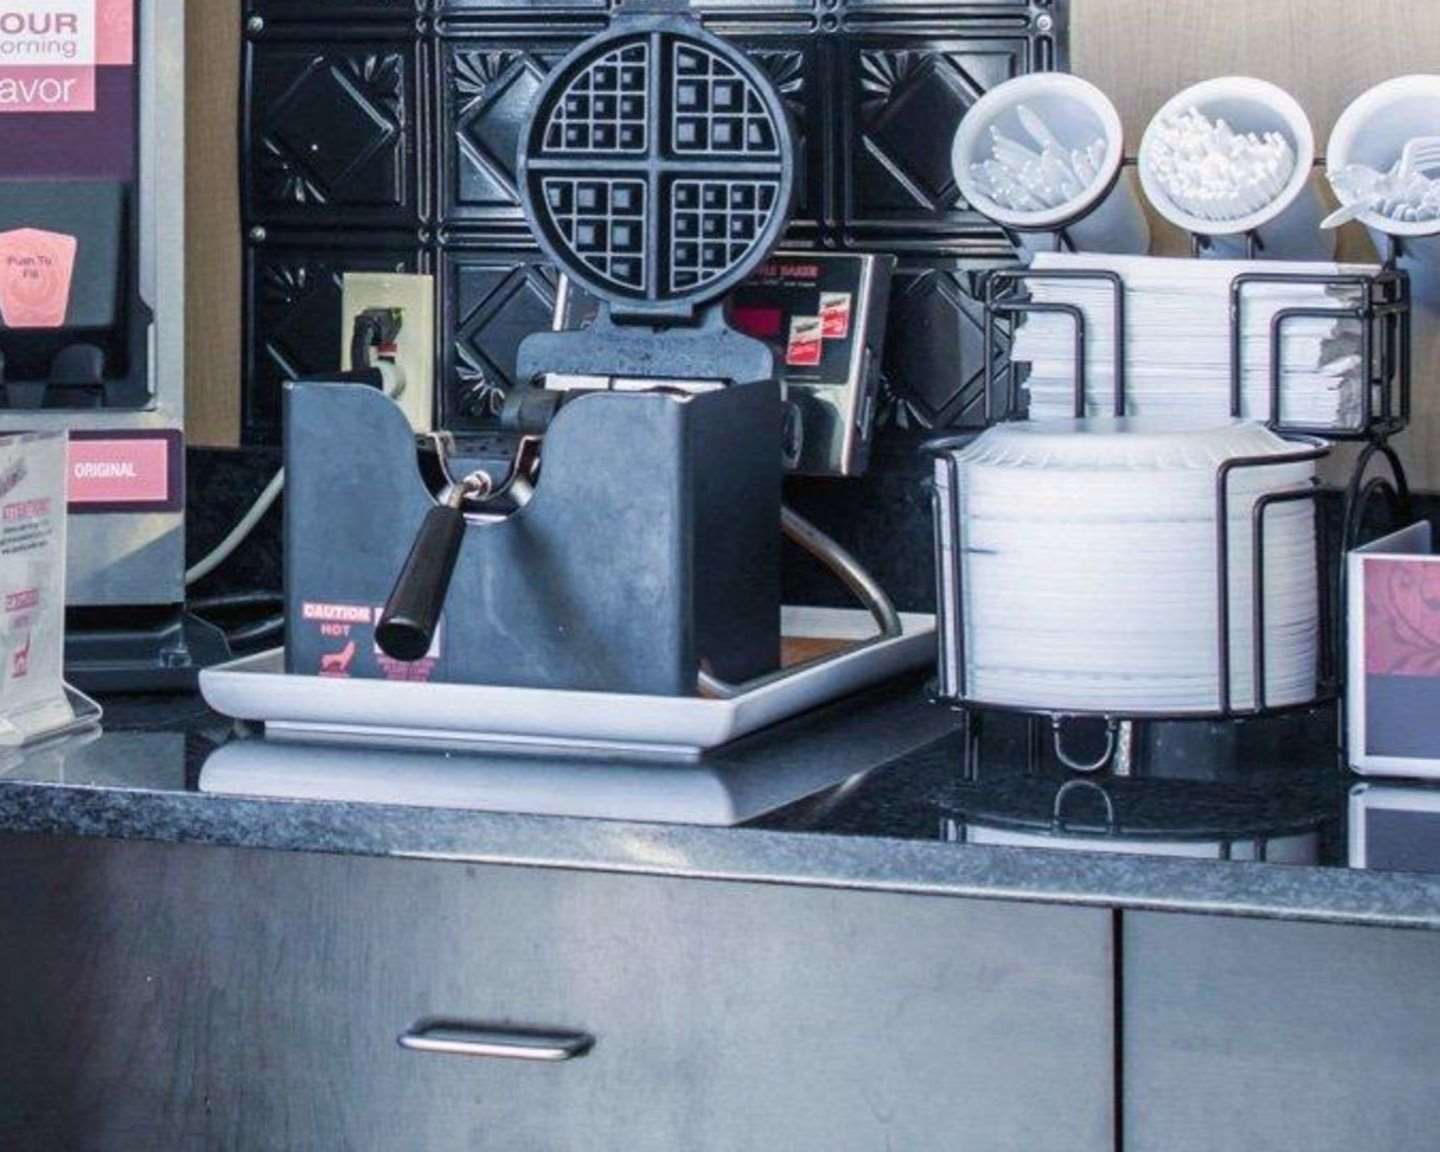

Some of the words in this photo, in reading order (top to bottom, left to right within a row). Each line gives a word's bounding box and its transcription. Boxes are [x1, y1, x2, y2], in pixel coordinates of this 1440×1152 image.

[74, 461, 137, 479] ORIGINAL
[303, 603, 371, 621] CAUTION
[321, 624, 350, 636] HOT
